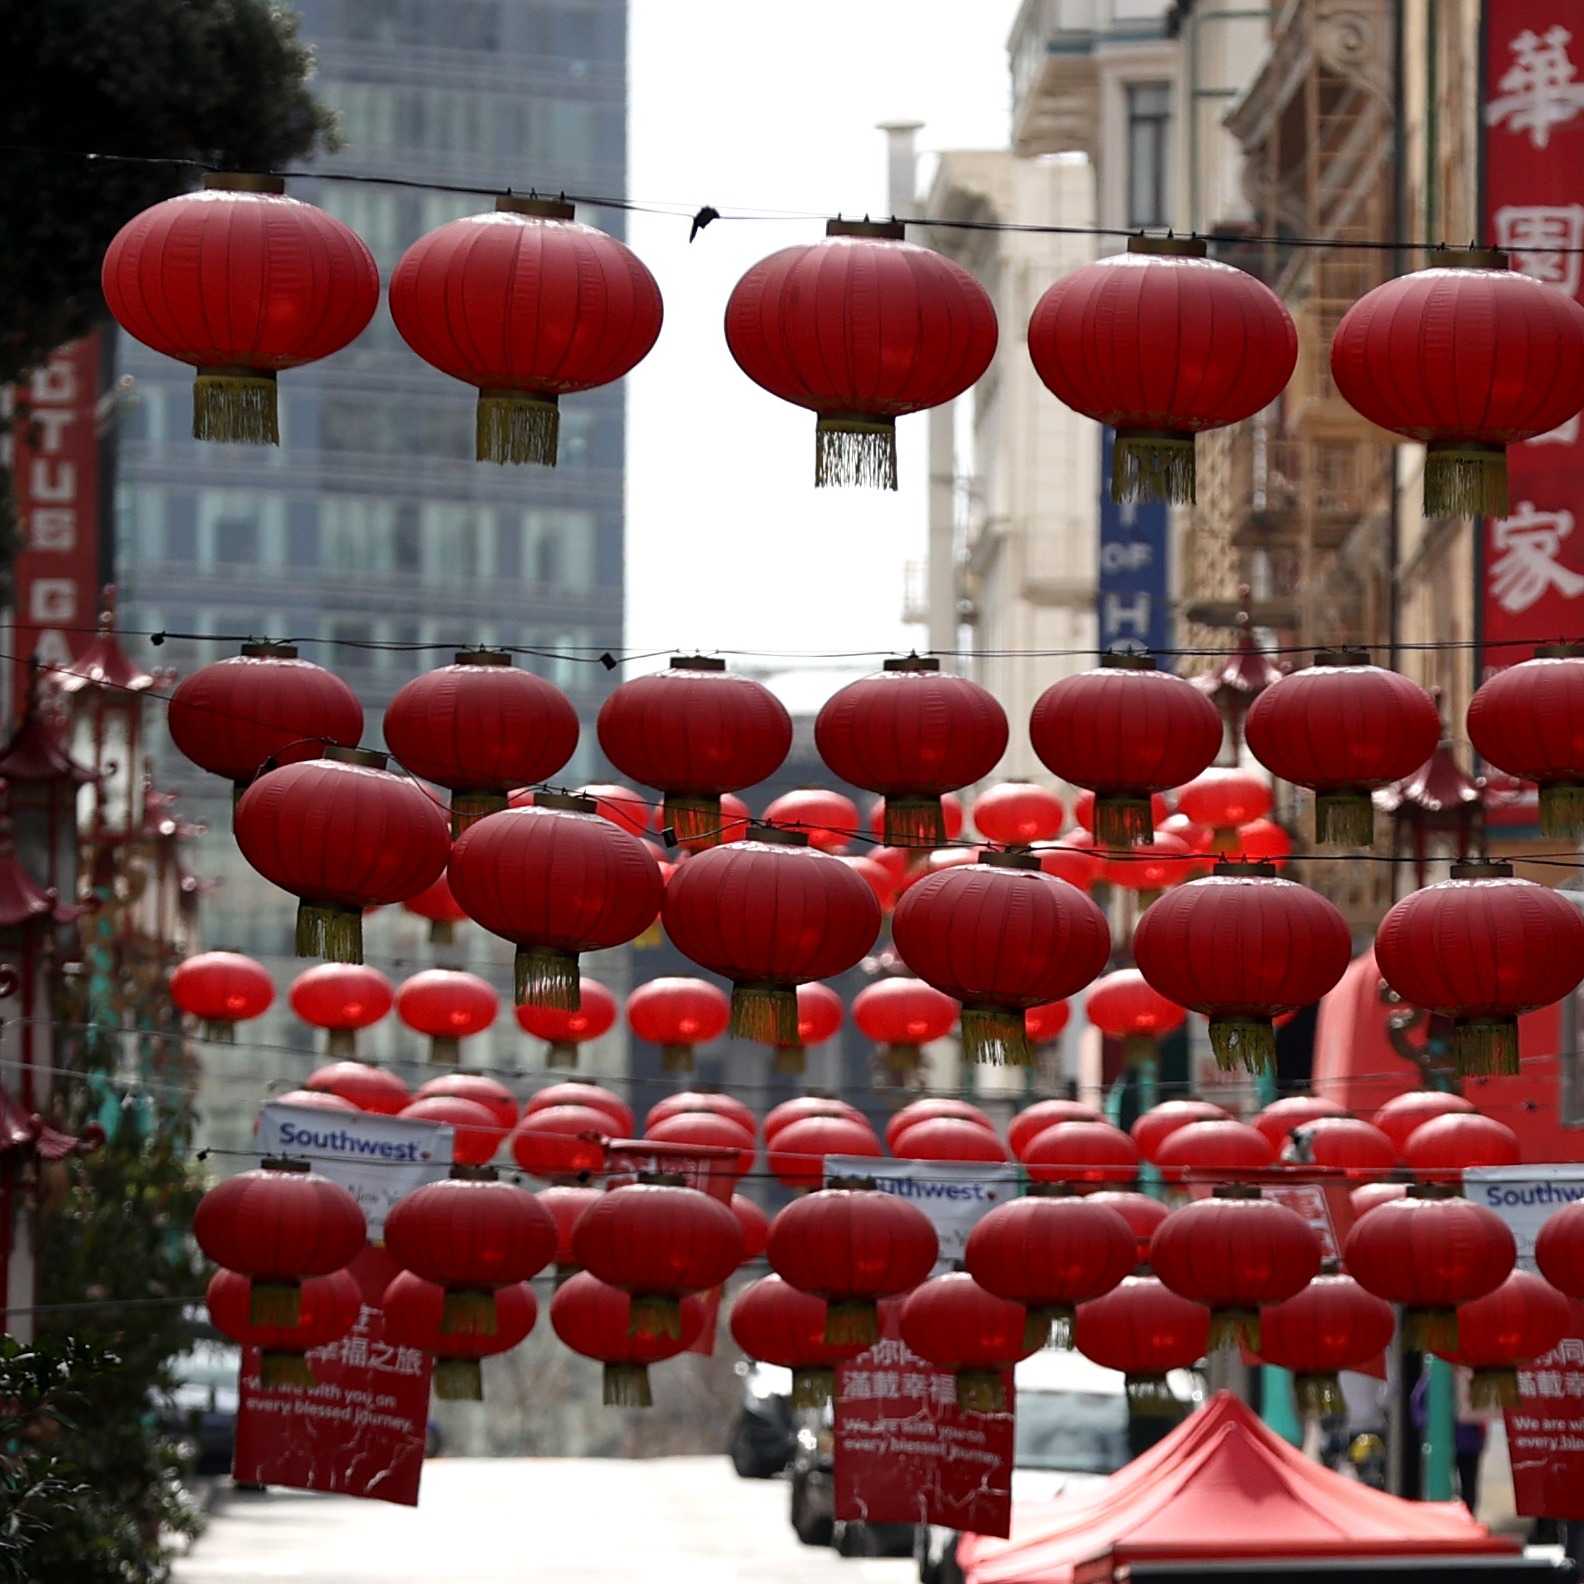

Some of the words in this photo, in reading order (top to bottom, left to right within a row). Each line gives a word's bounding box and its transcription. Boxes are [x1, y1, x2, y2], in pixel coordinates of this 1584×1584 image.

[279, 1121, 418, 1162] Southwest
[246, 1398, 293, 1415] every
[294, 1400, 350, 1420] blessed
[1513, 1415, 1540, 1431] We
[1542, 1418, 1566, 1431] are
[1515, 1436, 1558, 1451] every
